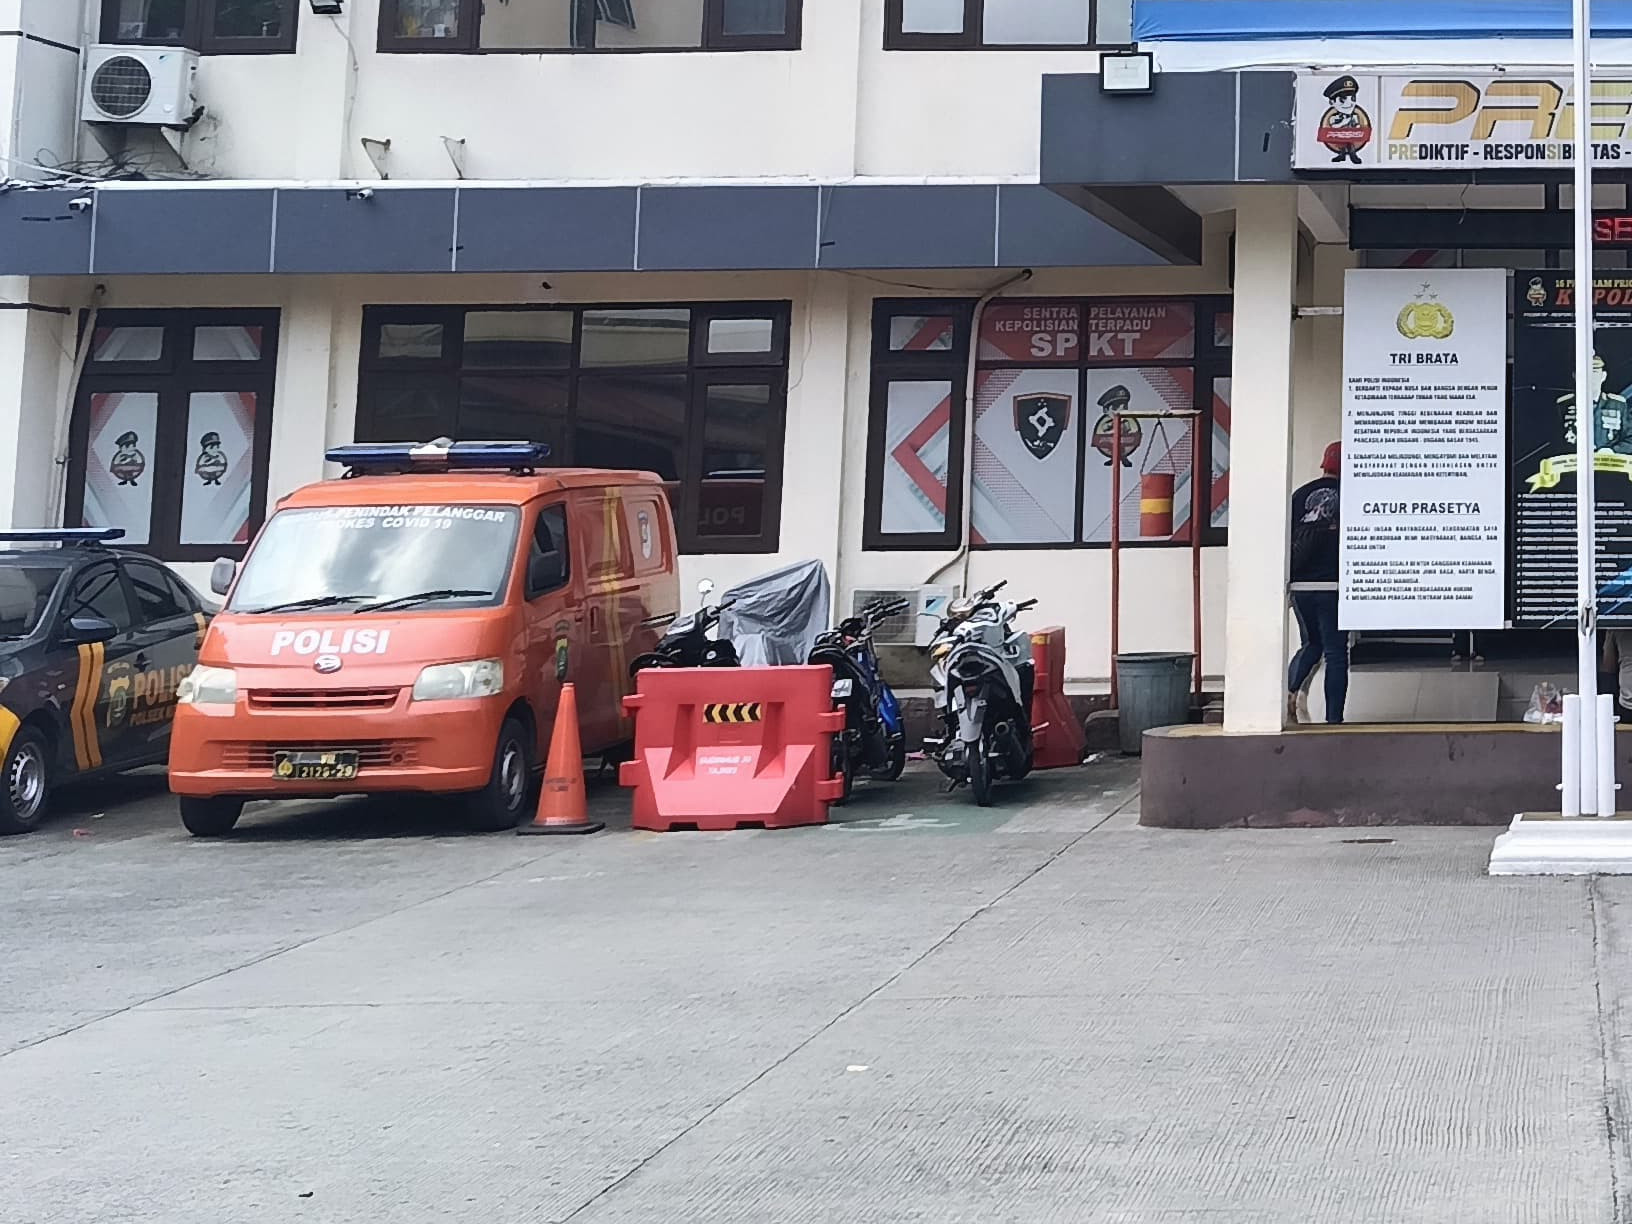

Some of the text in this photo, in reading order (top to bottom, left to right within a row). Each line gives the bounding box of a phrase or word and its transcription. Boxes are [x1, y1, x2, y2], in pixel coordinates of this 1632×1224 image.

[1388, 144, 1469, 161] PREDIKTIF
[1023, 306, 1166, 319] SENTRA PELAYANAN
[995, 319, 1151, 332] KEPOLISIAN TERPADU
[1390, 353, 1459, 364] TRI BRATA
[412, 505, 505, 523] PELANGGAR
[1363, 503, 1481, 514] CATUR PRASETYA
[382, 517, 429, 528] COVID
[434, 518, 452, 530] 19
[271, 628, 391, 656] POLISI
